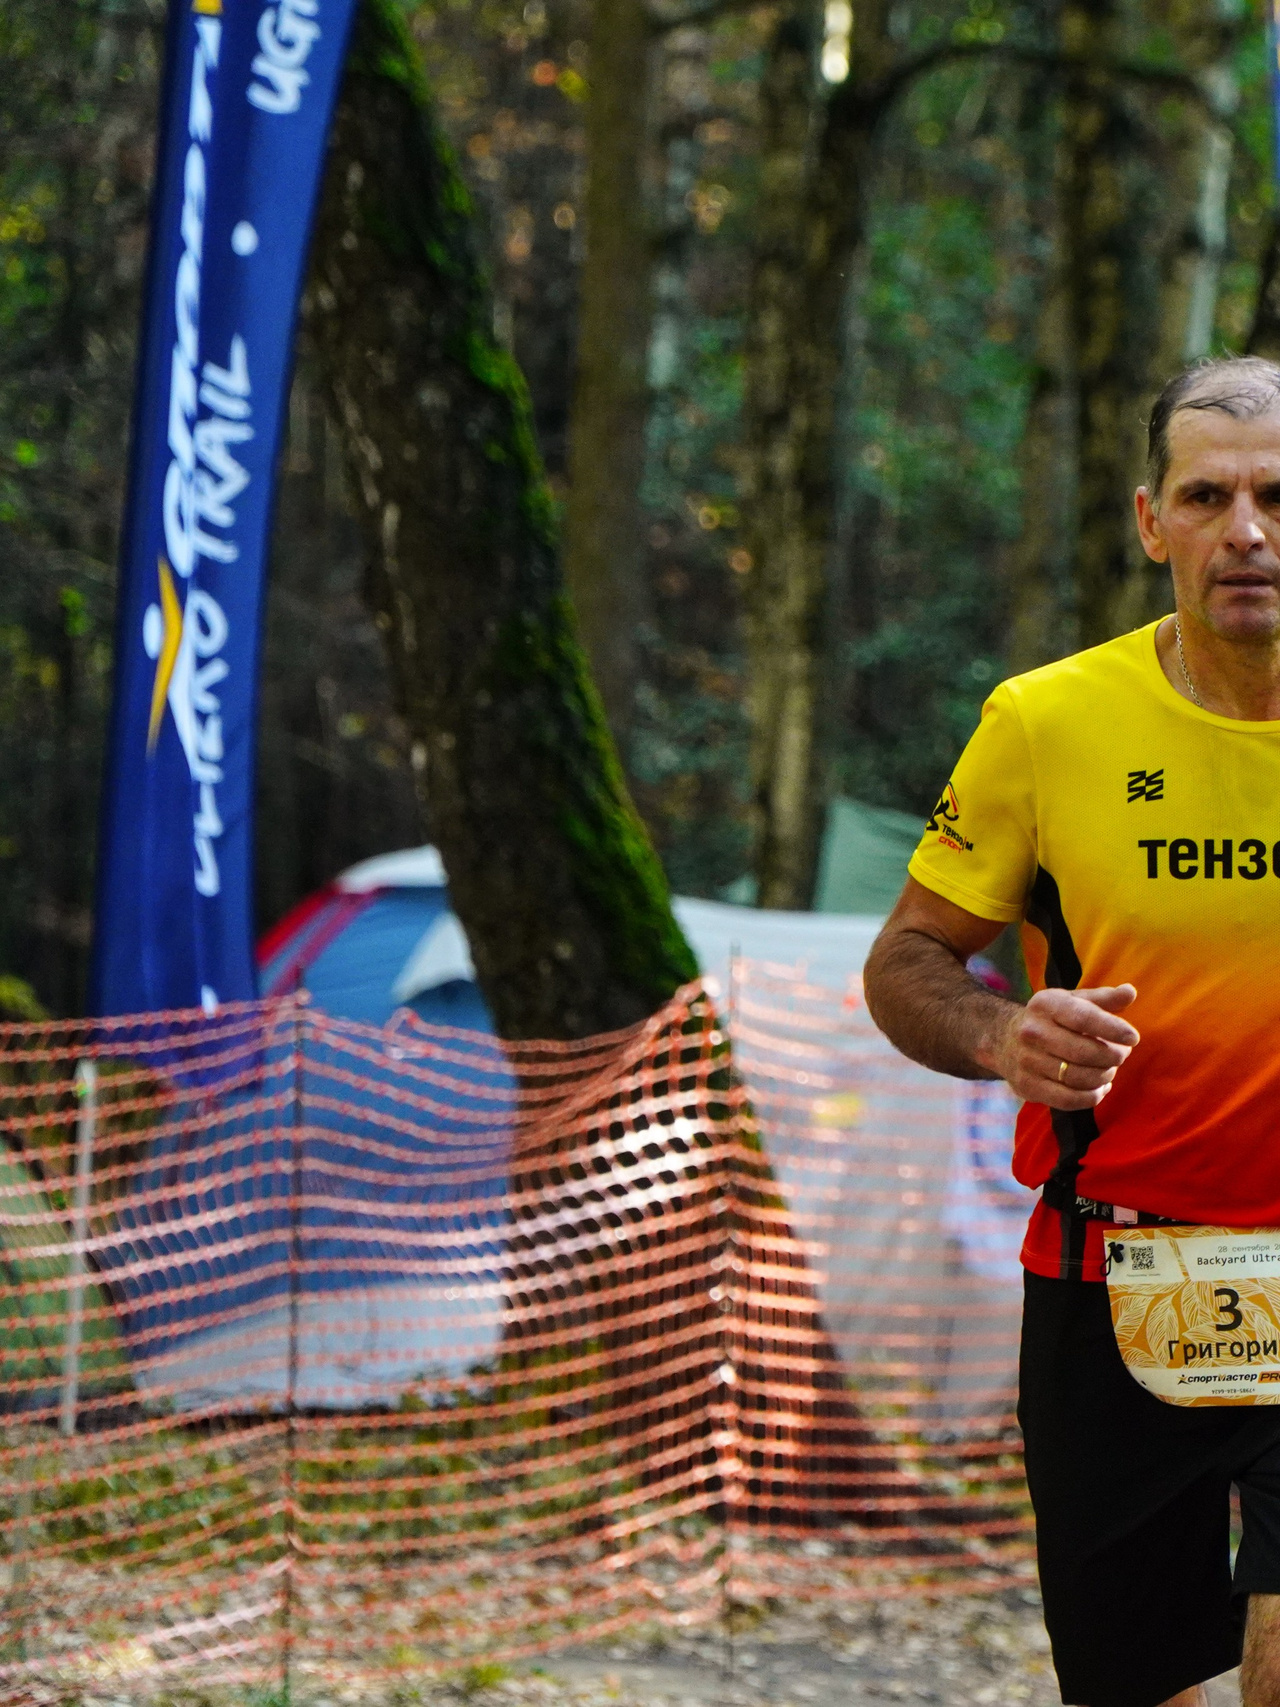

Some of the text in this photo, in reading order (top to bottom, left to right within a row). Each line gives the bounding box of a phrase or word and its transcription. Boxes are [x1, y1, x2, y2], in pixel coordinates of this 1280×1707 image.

[1231, 1243, 1271, 1254] сентября
[1197, 1254, 1246, 1266] Backyard
[1213, 1287, 1243, 1332] 3
